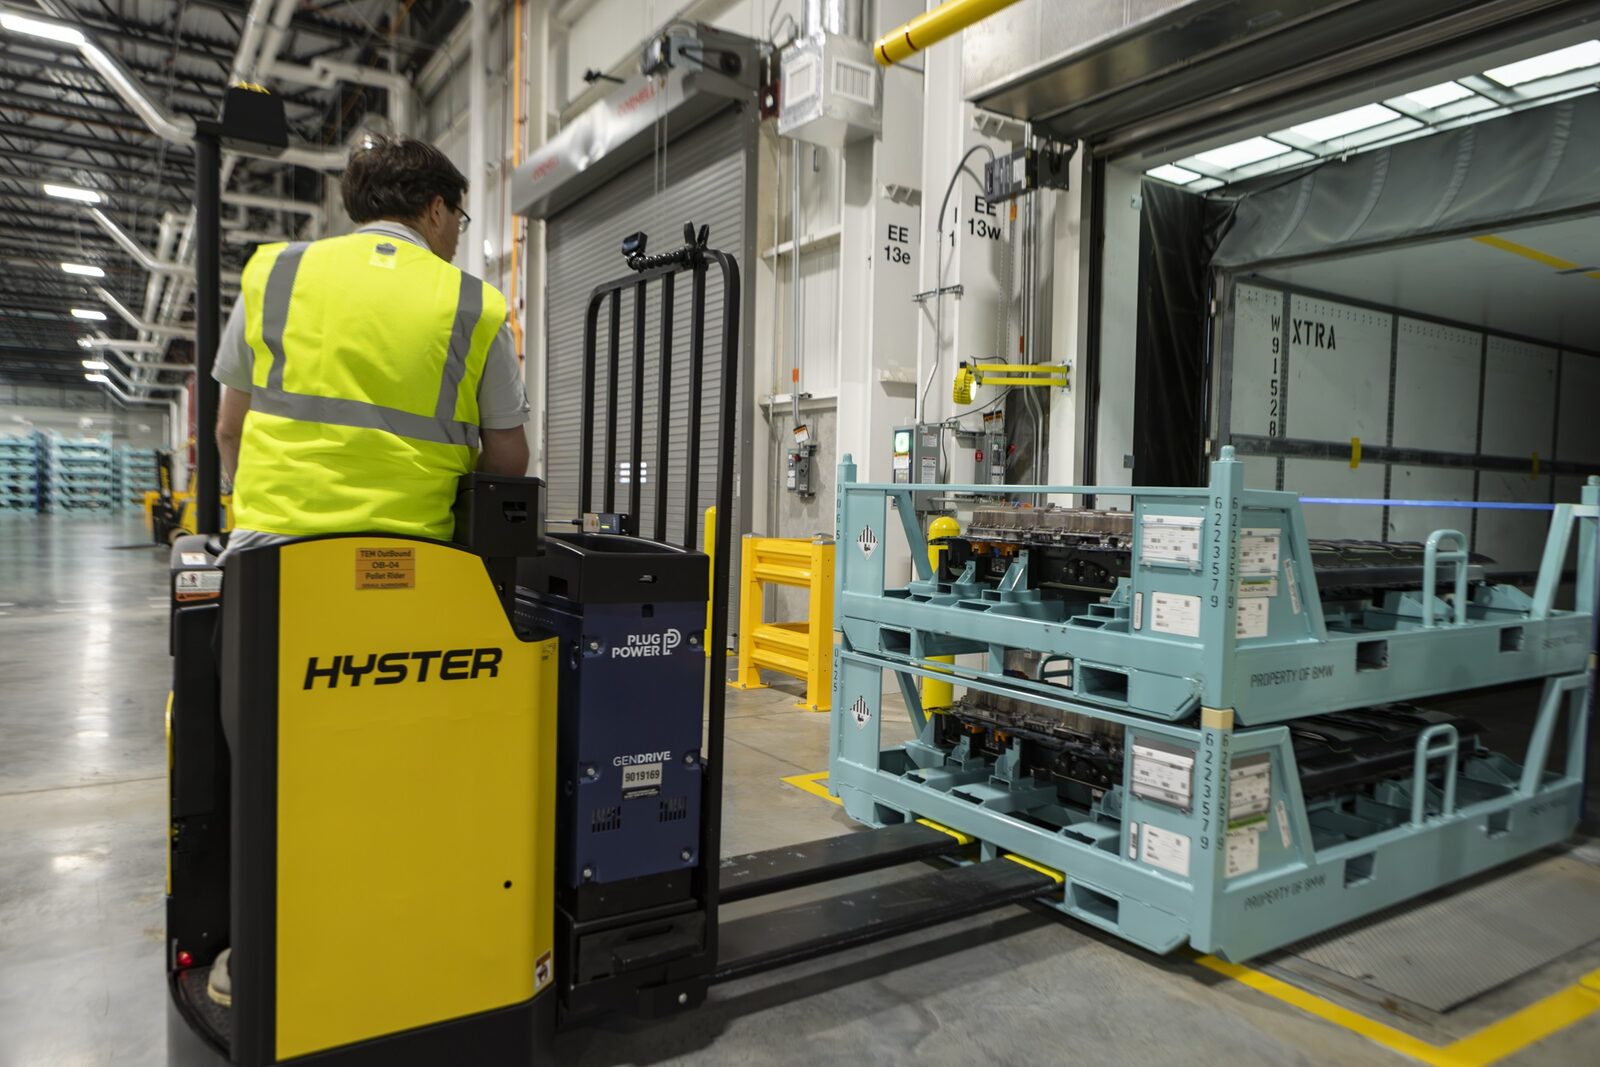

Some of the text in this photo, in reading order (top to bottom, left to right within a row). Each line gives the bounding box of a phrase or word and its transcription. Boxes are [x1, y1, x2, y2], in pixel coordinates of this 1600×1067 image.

[887, 224, 909, 244] EE
[968, 218, 1001, 241] 13w
[884, 245, 911, 265] 13e
[1292, 317, 1336, 351] XTRA
[1210, 496, 1223, 608] 6223579
[627, 633, 661, 646] PLUG
[612, 645, 661, 659] POWER
[302, 647, 504, 691] HYSTER
[1250, 664, 1335, 689] PROPERTY OF BMW
[613, 751, 671, 767] GENDRIVE
[624, 769, 661, 783] 9019169
